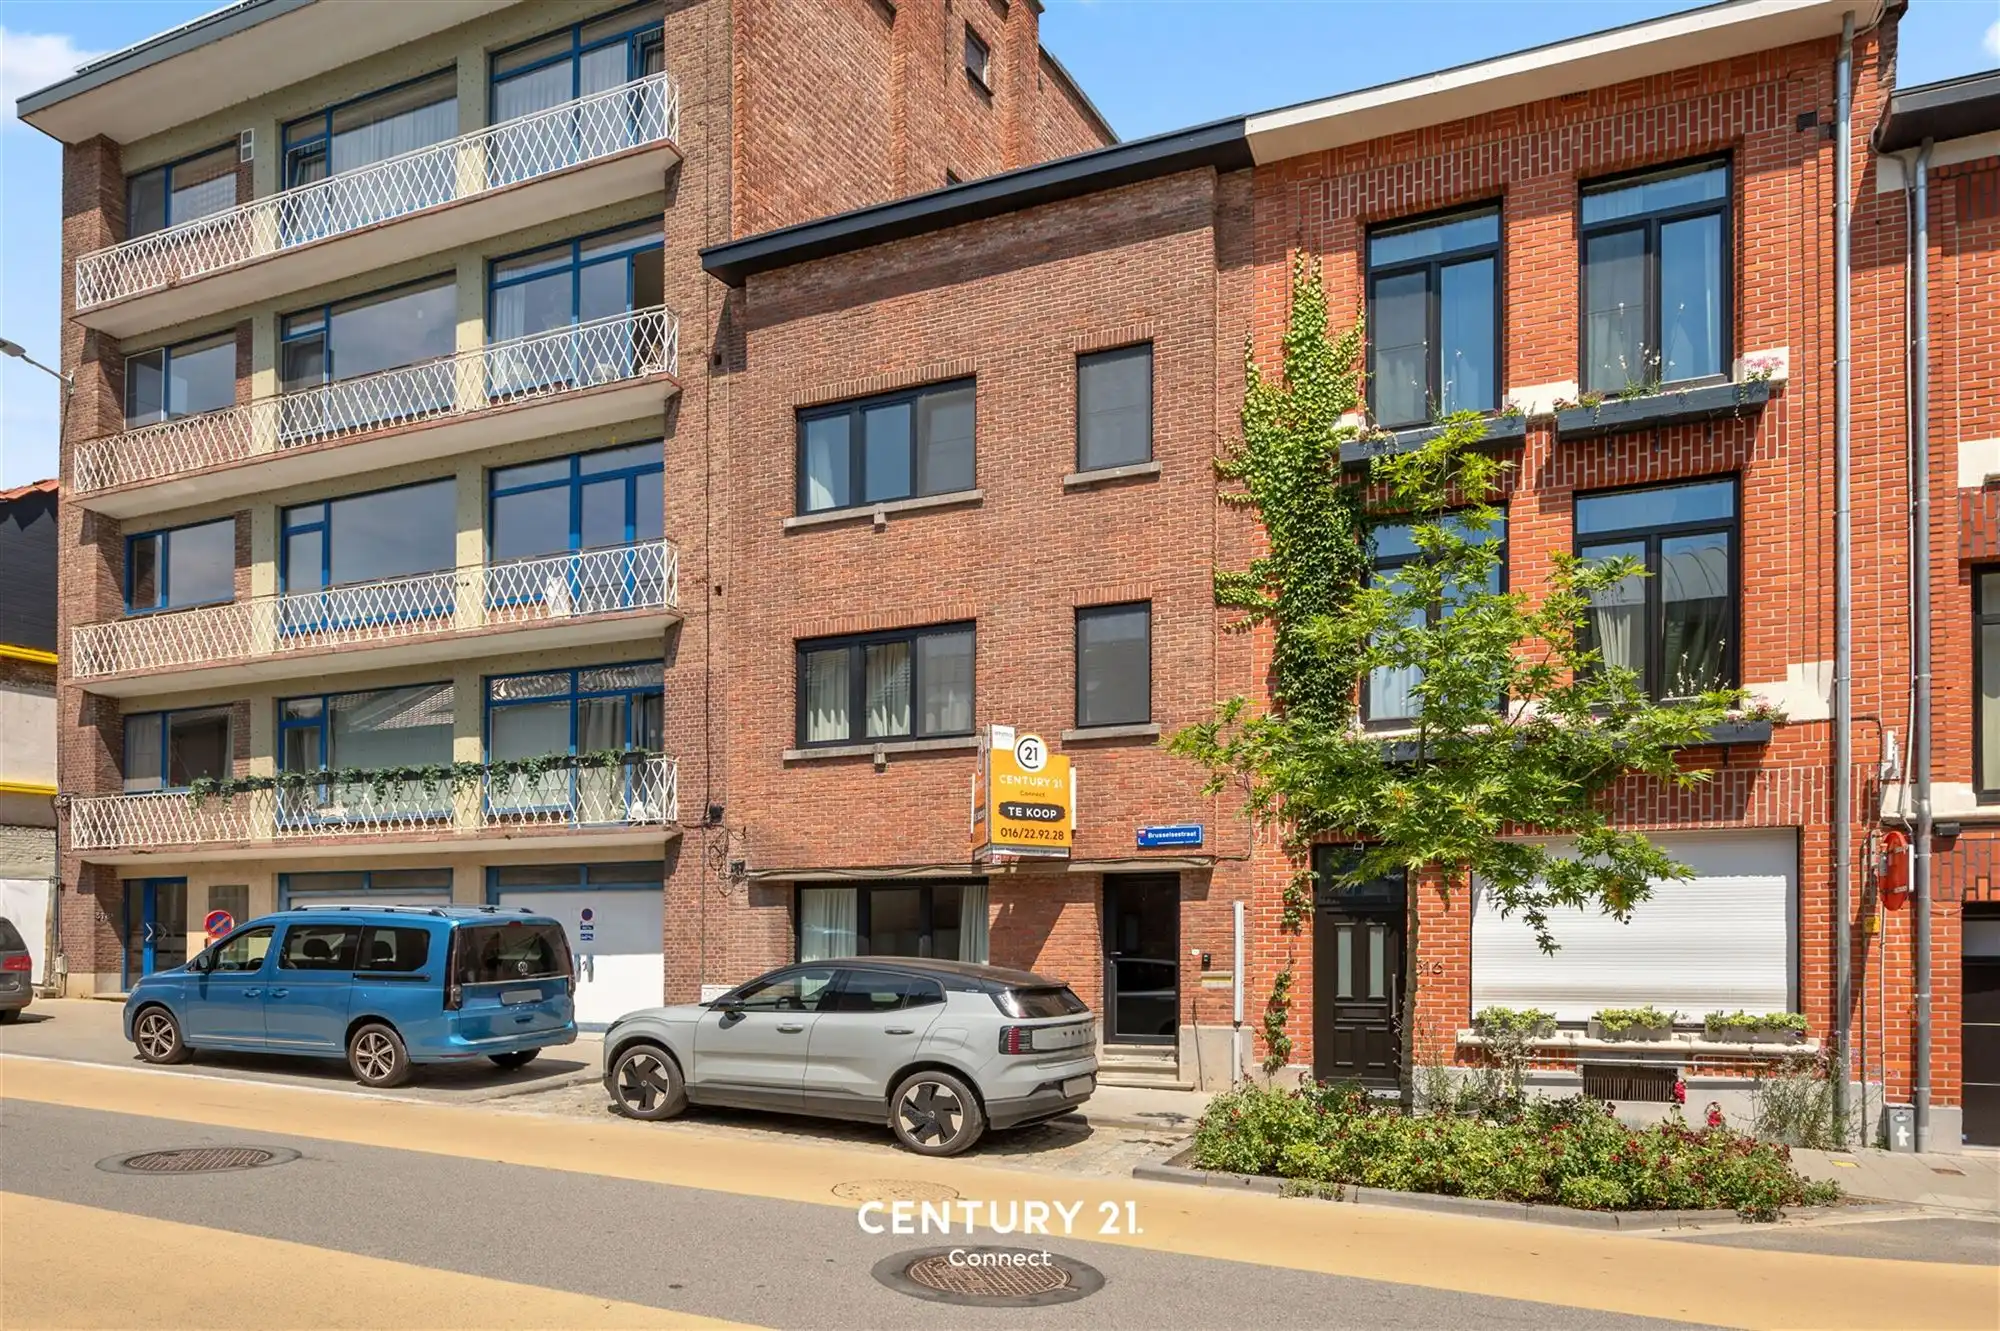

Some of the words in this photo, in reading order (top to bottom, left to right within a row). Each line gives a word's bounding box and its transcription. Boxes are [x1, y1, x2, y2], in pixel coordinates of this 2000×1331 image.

[999, 774, 1051, 787] CENTURY
[1052, 777, 1064, 789] 21
[1020, 790, 1046, 798] Connect
[1008, 806, 1023, 817] TE
[1026, 808, 1057, 819] KOOP
[1000, 827, 1065, 841] 016/22.92.28
[1148, 831, 1197, 839] Brusselsestraat
